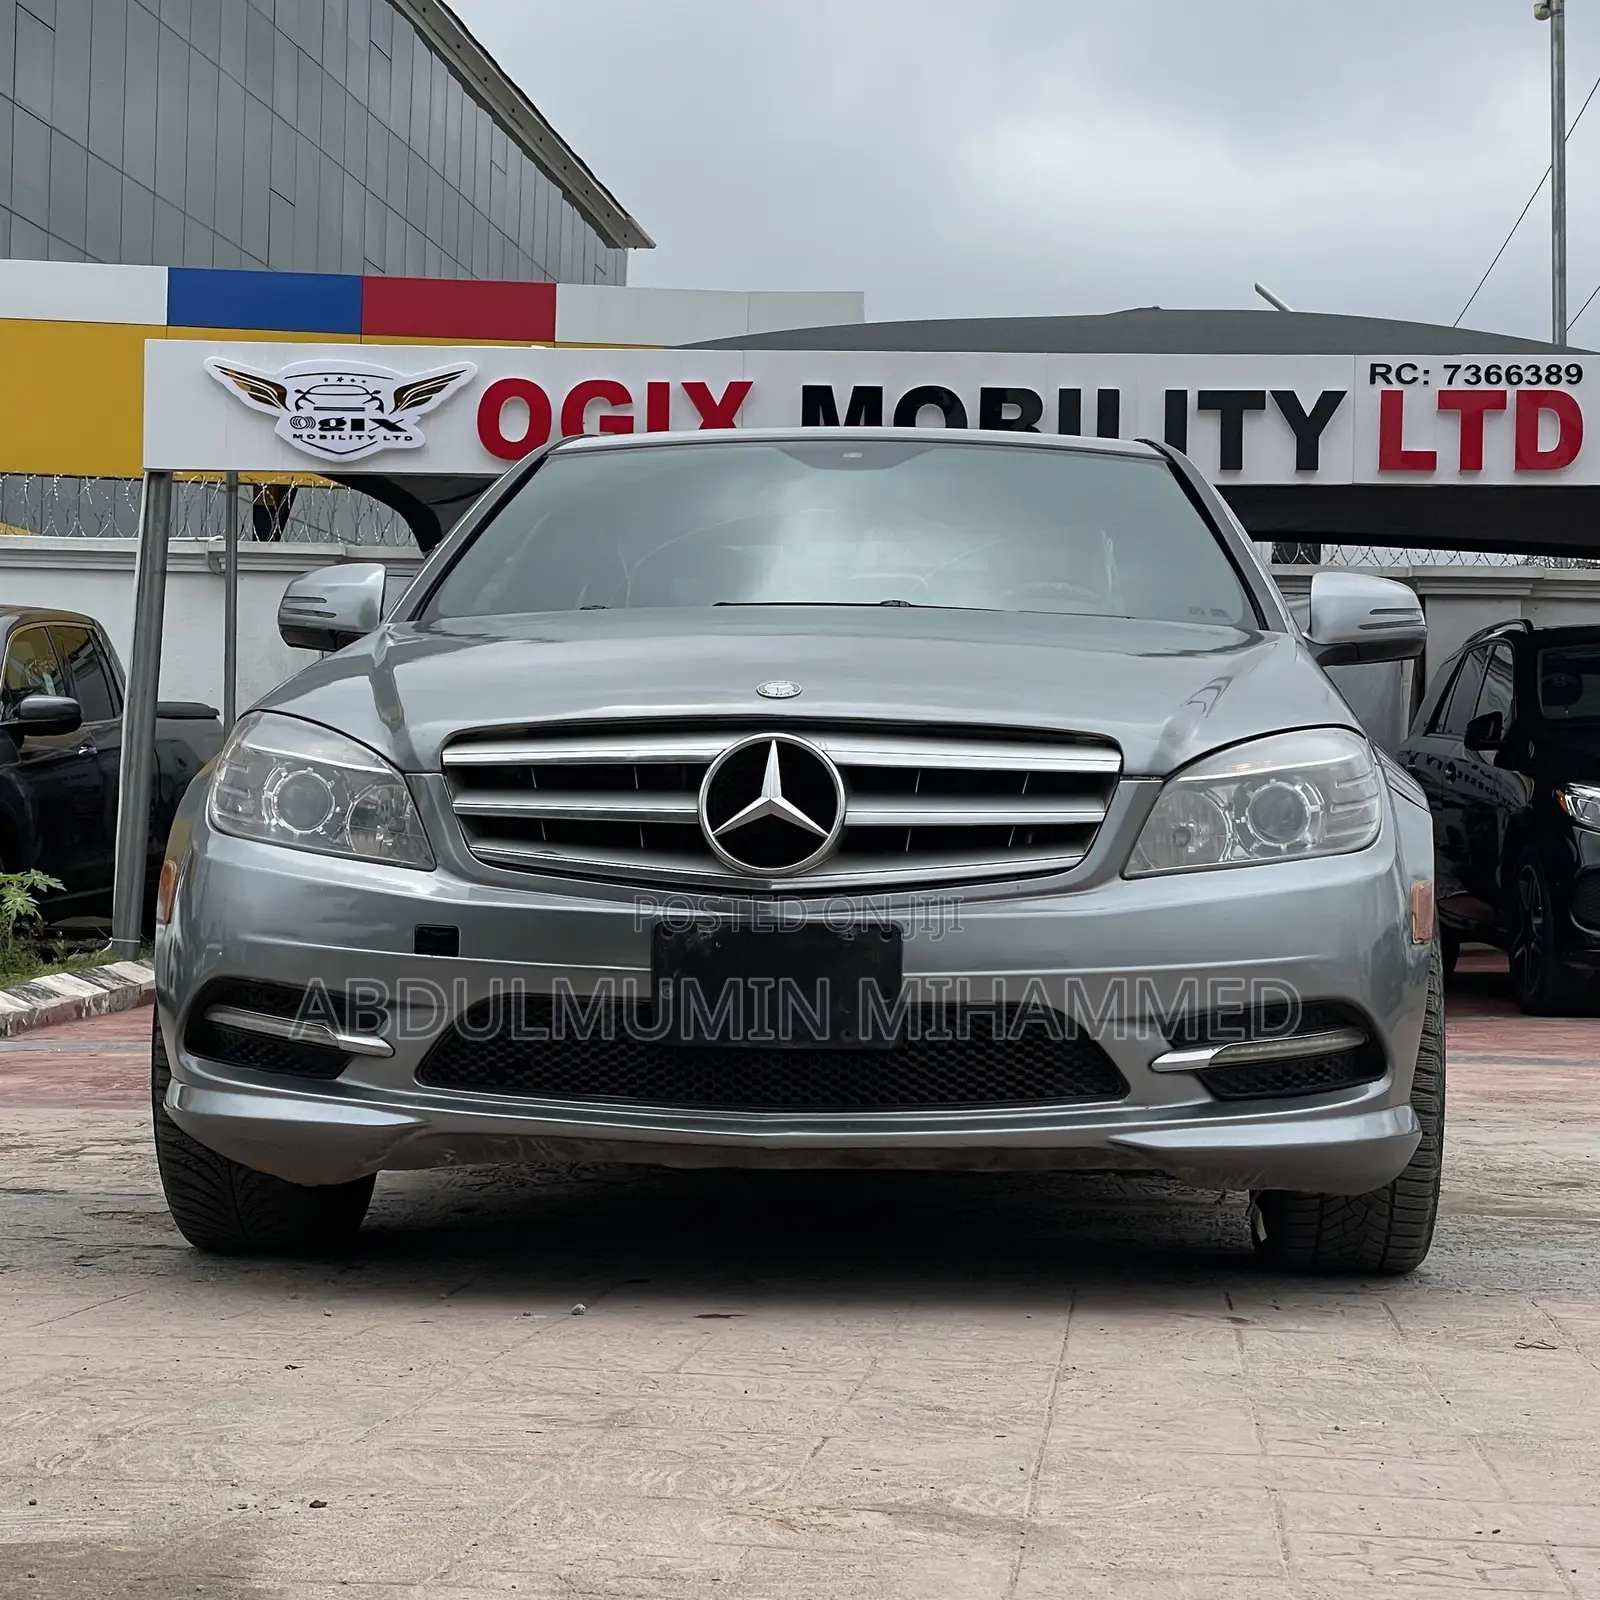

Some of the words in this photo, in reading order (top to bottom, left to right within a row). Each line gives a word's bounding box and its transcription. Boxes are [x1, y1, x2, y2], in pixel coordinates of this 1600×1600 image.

[1369, 363, 1430, 386] RC:
[1443, 363, 1584, 386] 7366389
[477, 377, 754, 461] OGIX
[1378, 389, 1584, 471] LTD
[292, 433, 376, 441] MOBILITY
